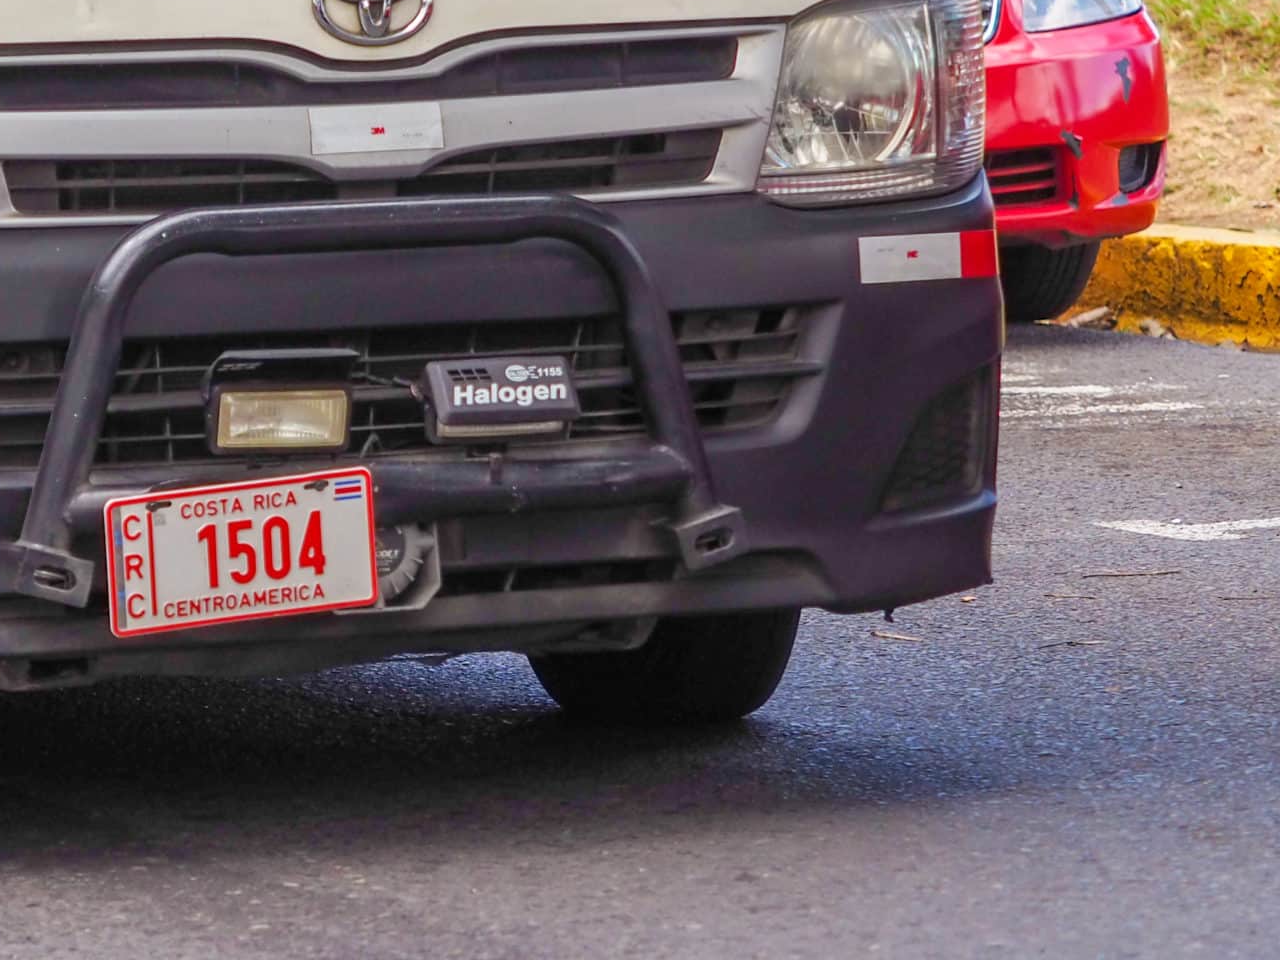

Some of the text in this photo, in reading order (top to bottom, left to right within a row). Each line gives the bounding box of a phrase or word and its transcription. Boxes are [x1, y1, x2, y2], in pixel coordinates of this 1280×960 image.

[537, 367, 563, 377] 1155
[453, 382, 567, 406] Halogen
[180, 490, 297, 519] COSTA RICA
[197, 510, 326, 589] 1504
[163, 583, 325, 619] CENTROAMERICA
